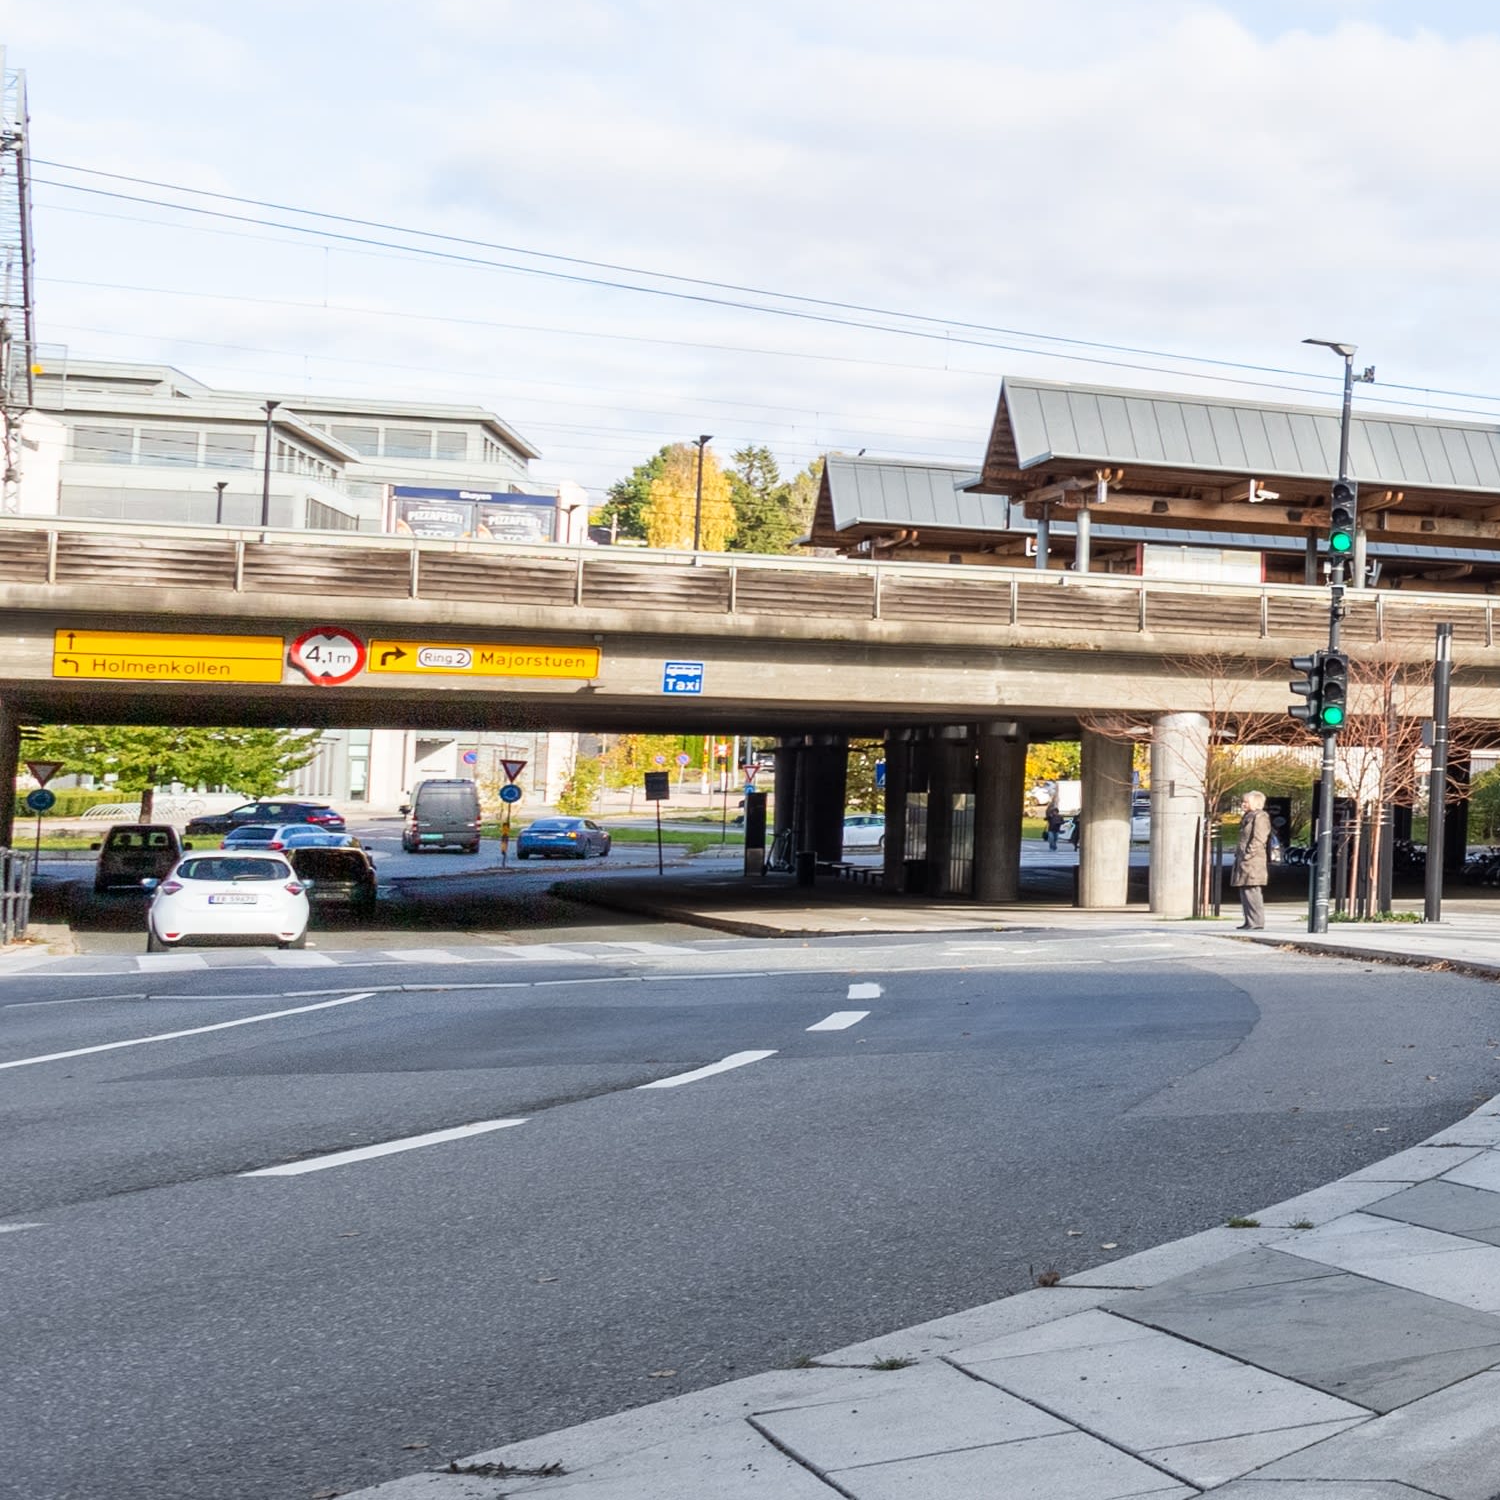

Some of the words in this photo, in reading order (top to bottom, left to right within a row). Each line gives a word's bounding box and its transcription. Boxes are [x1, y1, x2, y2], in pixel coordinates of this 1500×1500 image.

[305, 645, 333, 664] 4.1
[337, 654, 351, 664] m
[424, 652, 453, 665] Ring
[456, 652, 466, 664] 2
[480, 651, 586, 669] Majorstuen
[92, 658, 231, 676] Holmenkollen
[666, 678, 700, 691] Taxi
